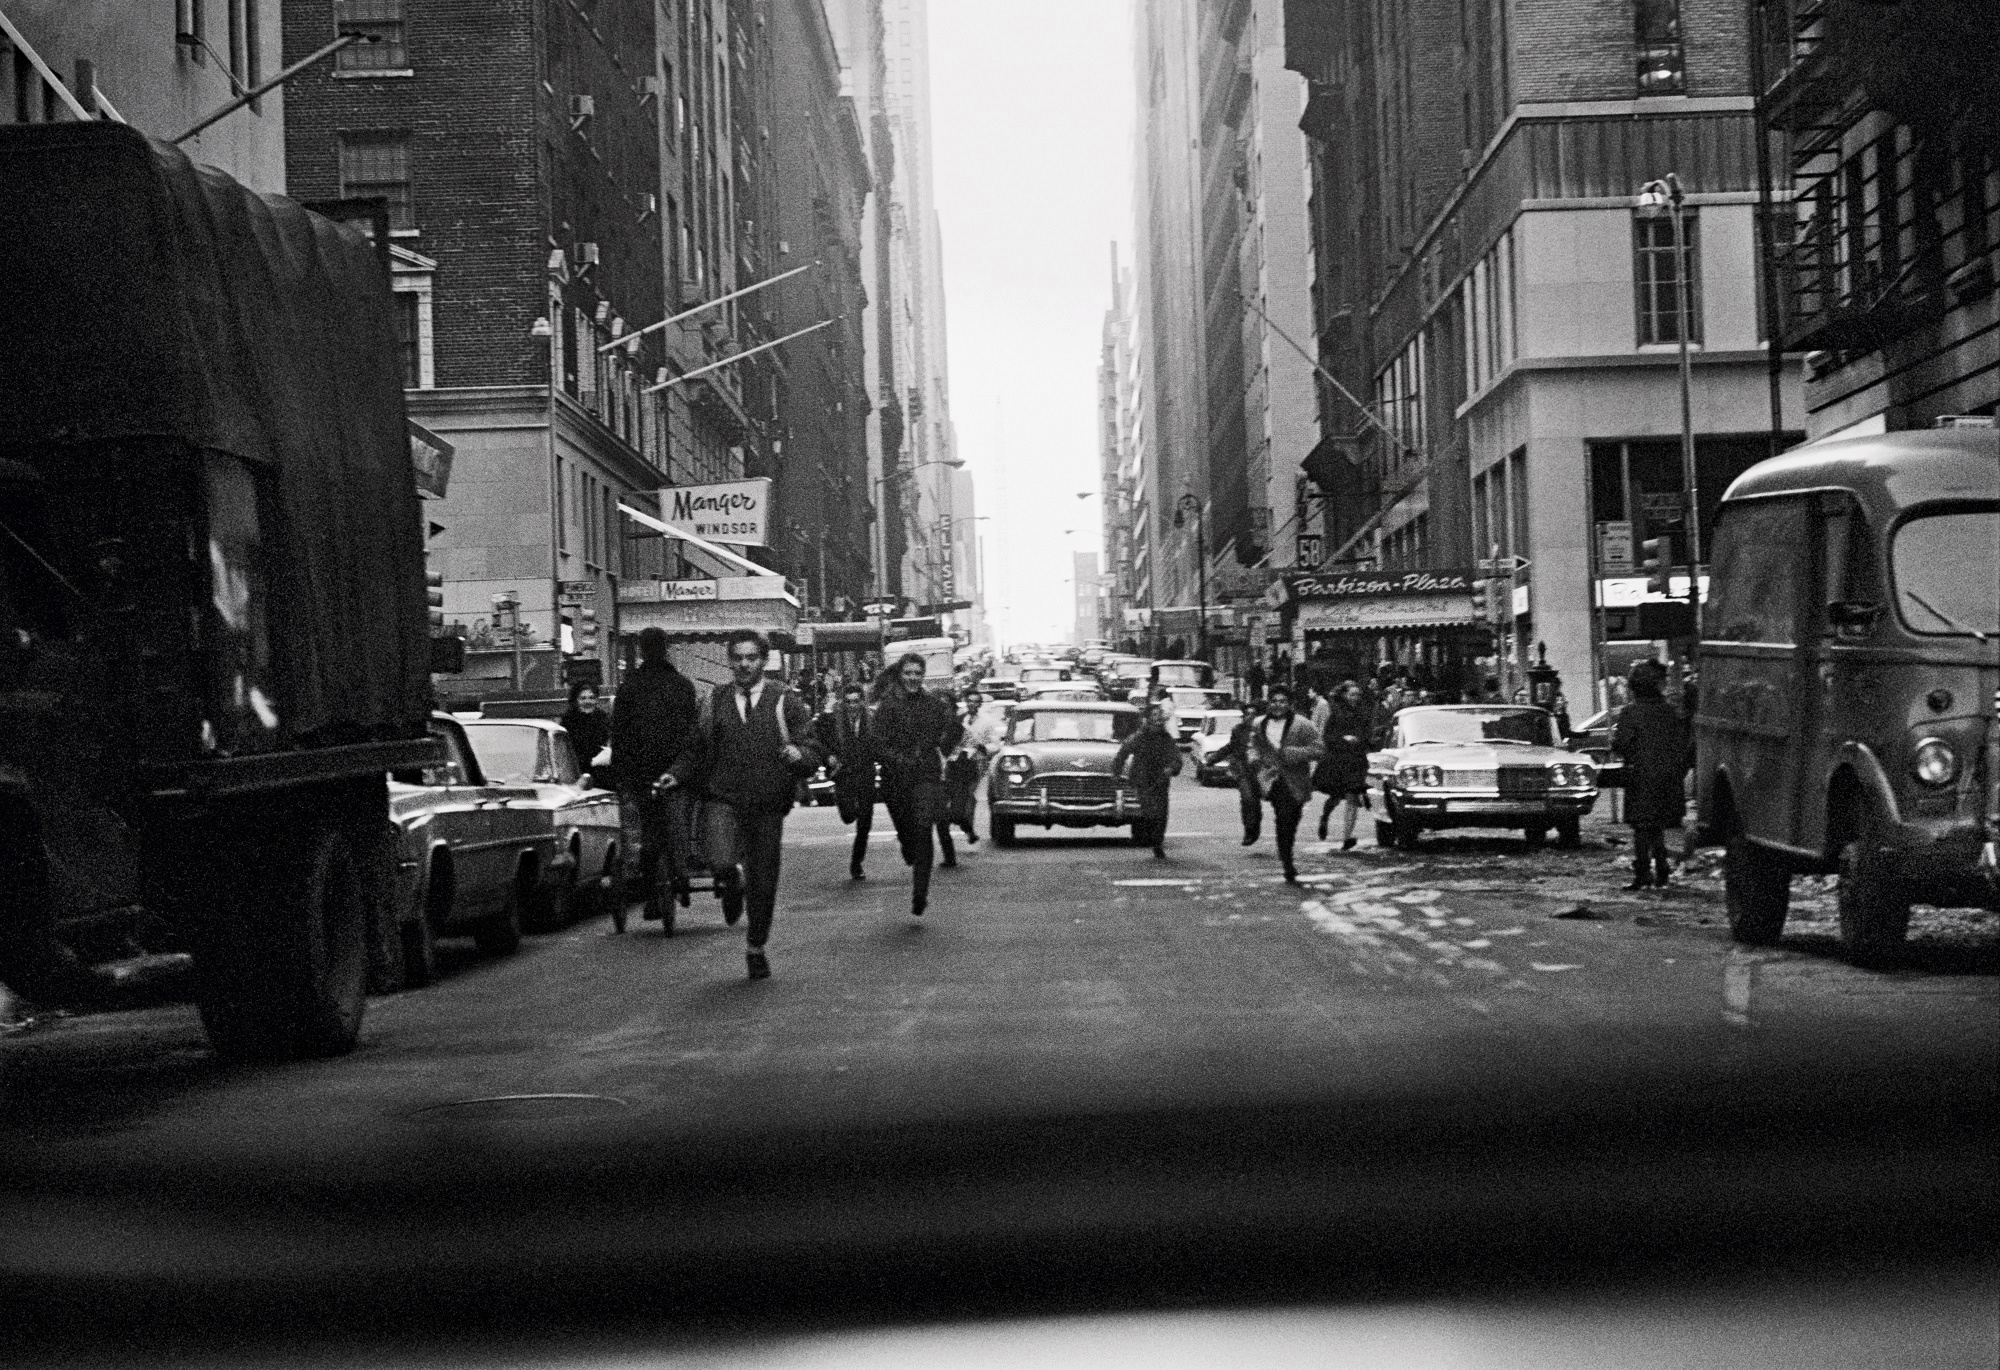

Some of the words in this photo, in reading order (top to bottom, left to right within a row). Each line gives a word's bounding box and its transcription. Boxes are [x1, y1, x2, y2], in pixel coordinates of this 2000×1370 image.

[672, 491, 756, 520] Manger
[696, 522, 758, 535] WINDSOR
[1300, 539, 1319, 566] 58
[666, 582, 713, 599] Manger
[1293, 574, 1466, 595] Barbizon-Plaza
